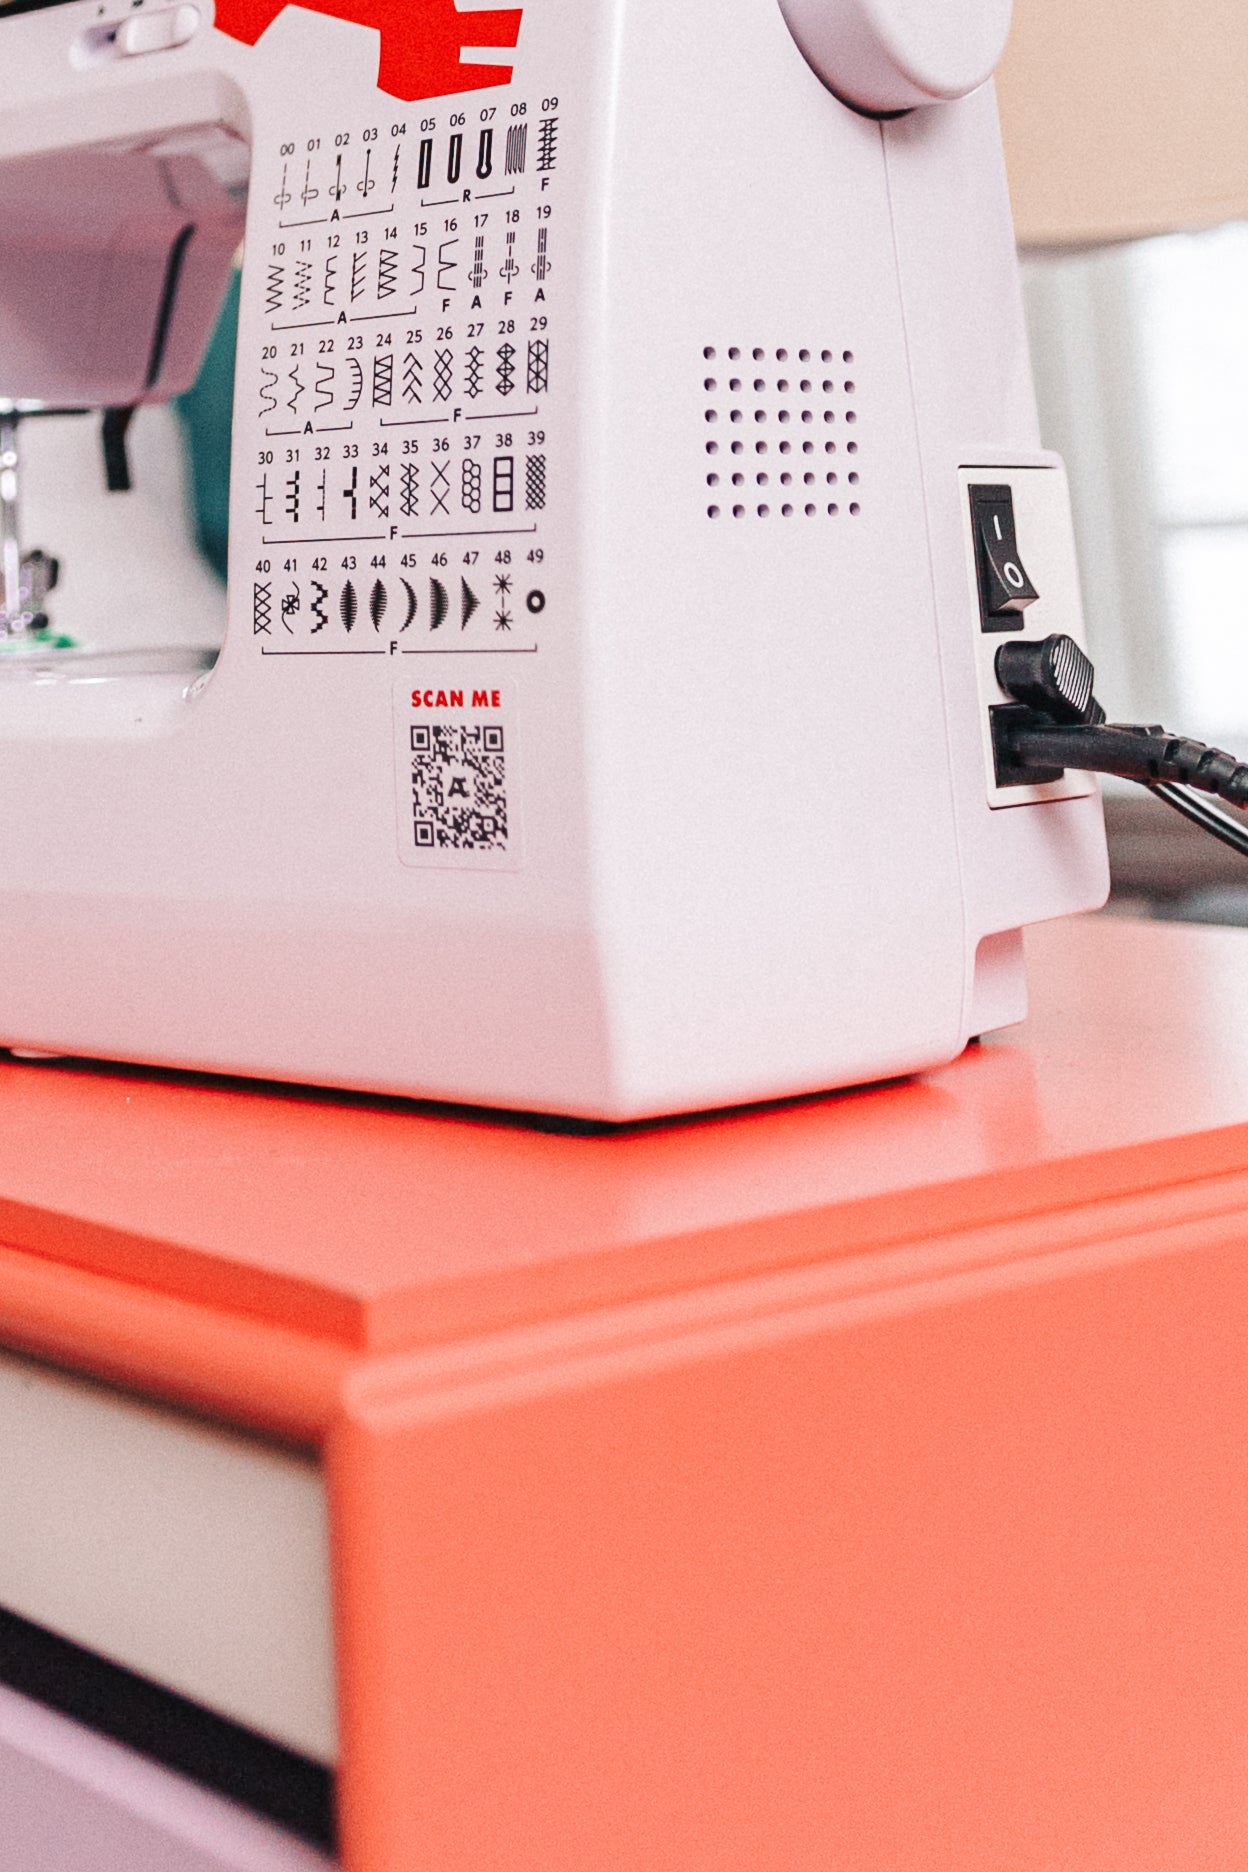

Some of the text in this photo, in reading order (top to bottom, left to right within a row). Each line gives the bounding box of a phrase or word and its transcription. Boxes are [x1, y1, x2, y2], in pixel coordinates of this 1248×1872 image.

[279, 96, 559, 157] 00 01 02 03 04 05 06 07 08 09
[330, 177, 550, 223] A R F
[272, 204, 552, 256] 10 11 12 13 14 15 16 17 18 19
[337, 287, 546, 325] A F A F A
[261, 316, 548, 360] 20 21 22 23 24 25 26 27 28 29
[303, 407, 462, 435] A F
[258, 430, 546, 465] 30 31 32 33 34 35 36 37 38 39
[390, 525, 398, 541] F
[255, 548, 544, 574] 40 41 42 43 44 45 46 47 48 49
[389, 640, 398, 656] F
[411, 689, 500, 708] SCAN ME
